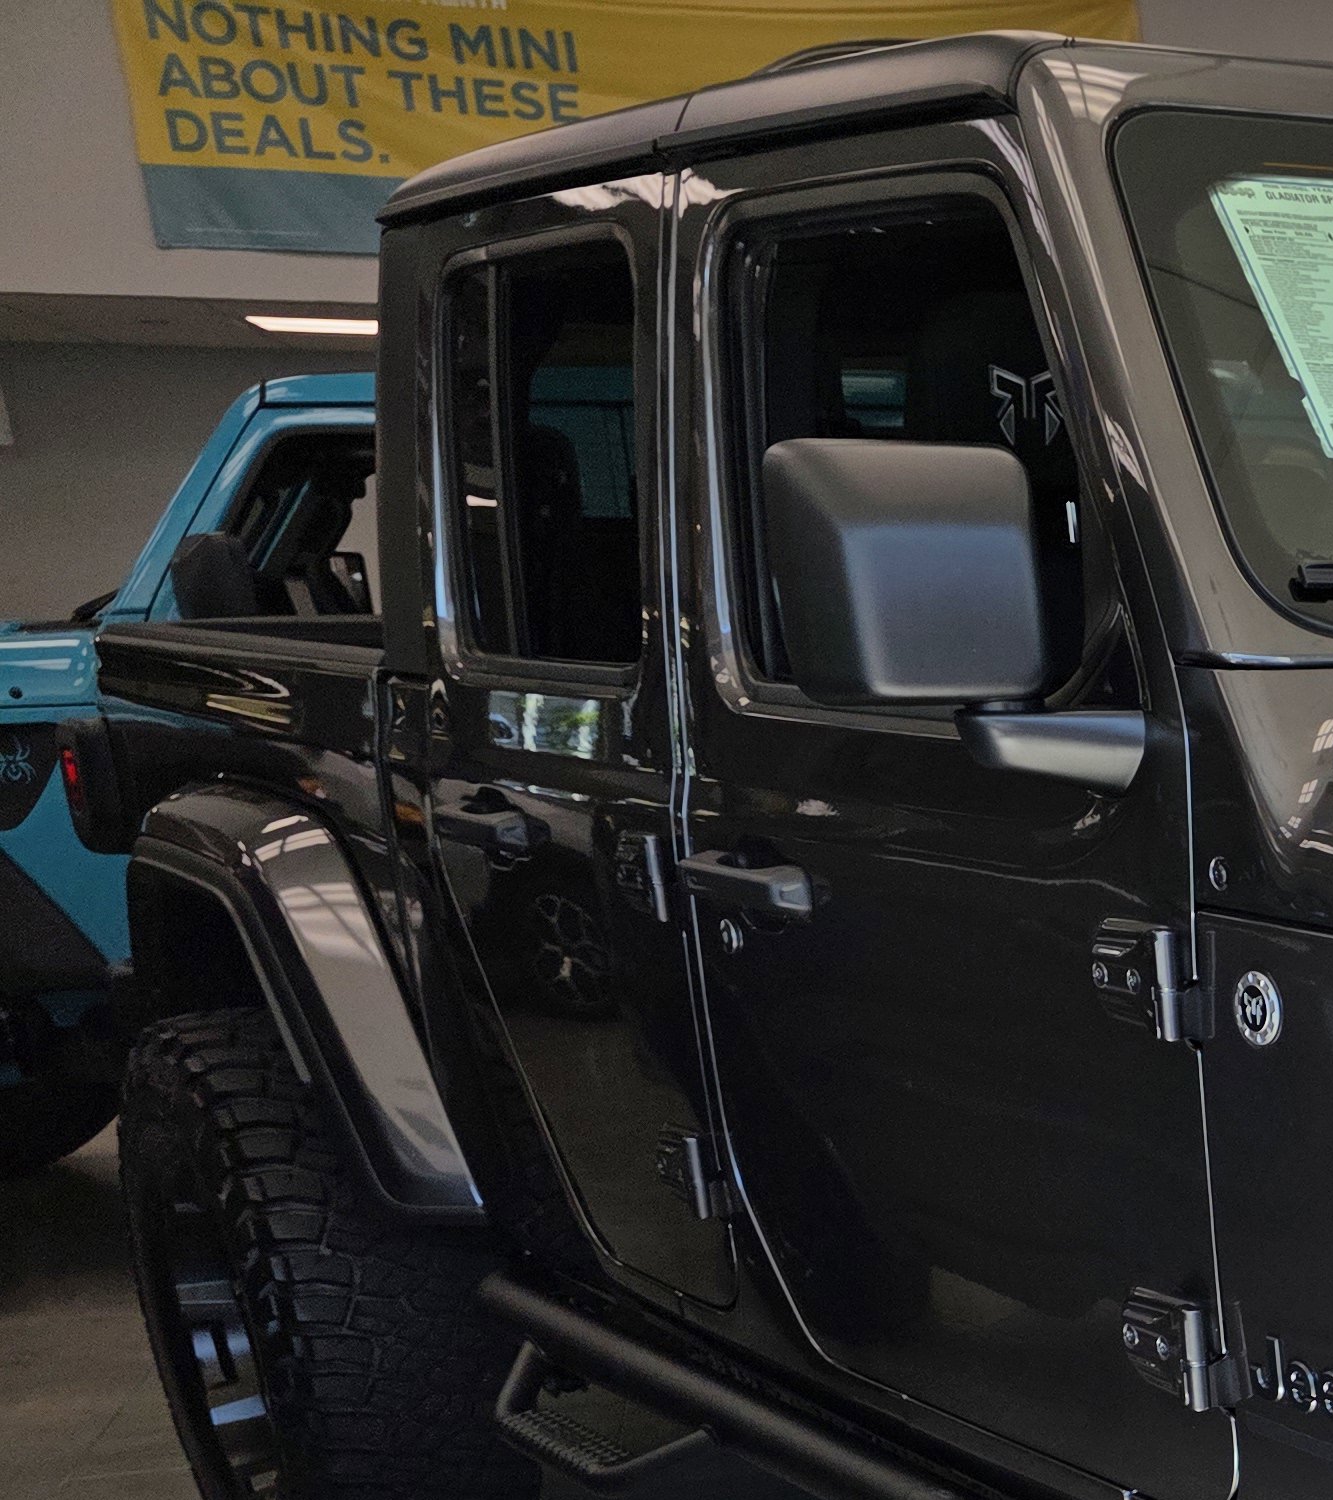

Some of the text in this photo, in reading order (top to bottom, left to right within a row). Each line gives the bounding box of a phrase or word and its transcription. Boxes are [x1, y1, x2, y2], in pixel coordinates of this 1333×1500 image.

[142, 0, 578, 74] NOTHING MINI
[158, 53, 582, 122] ABOUT THESE
[164, 109, 391, 164] DEALS.
[1265, 190, 1319, 204] GLADIATOR
